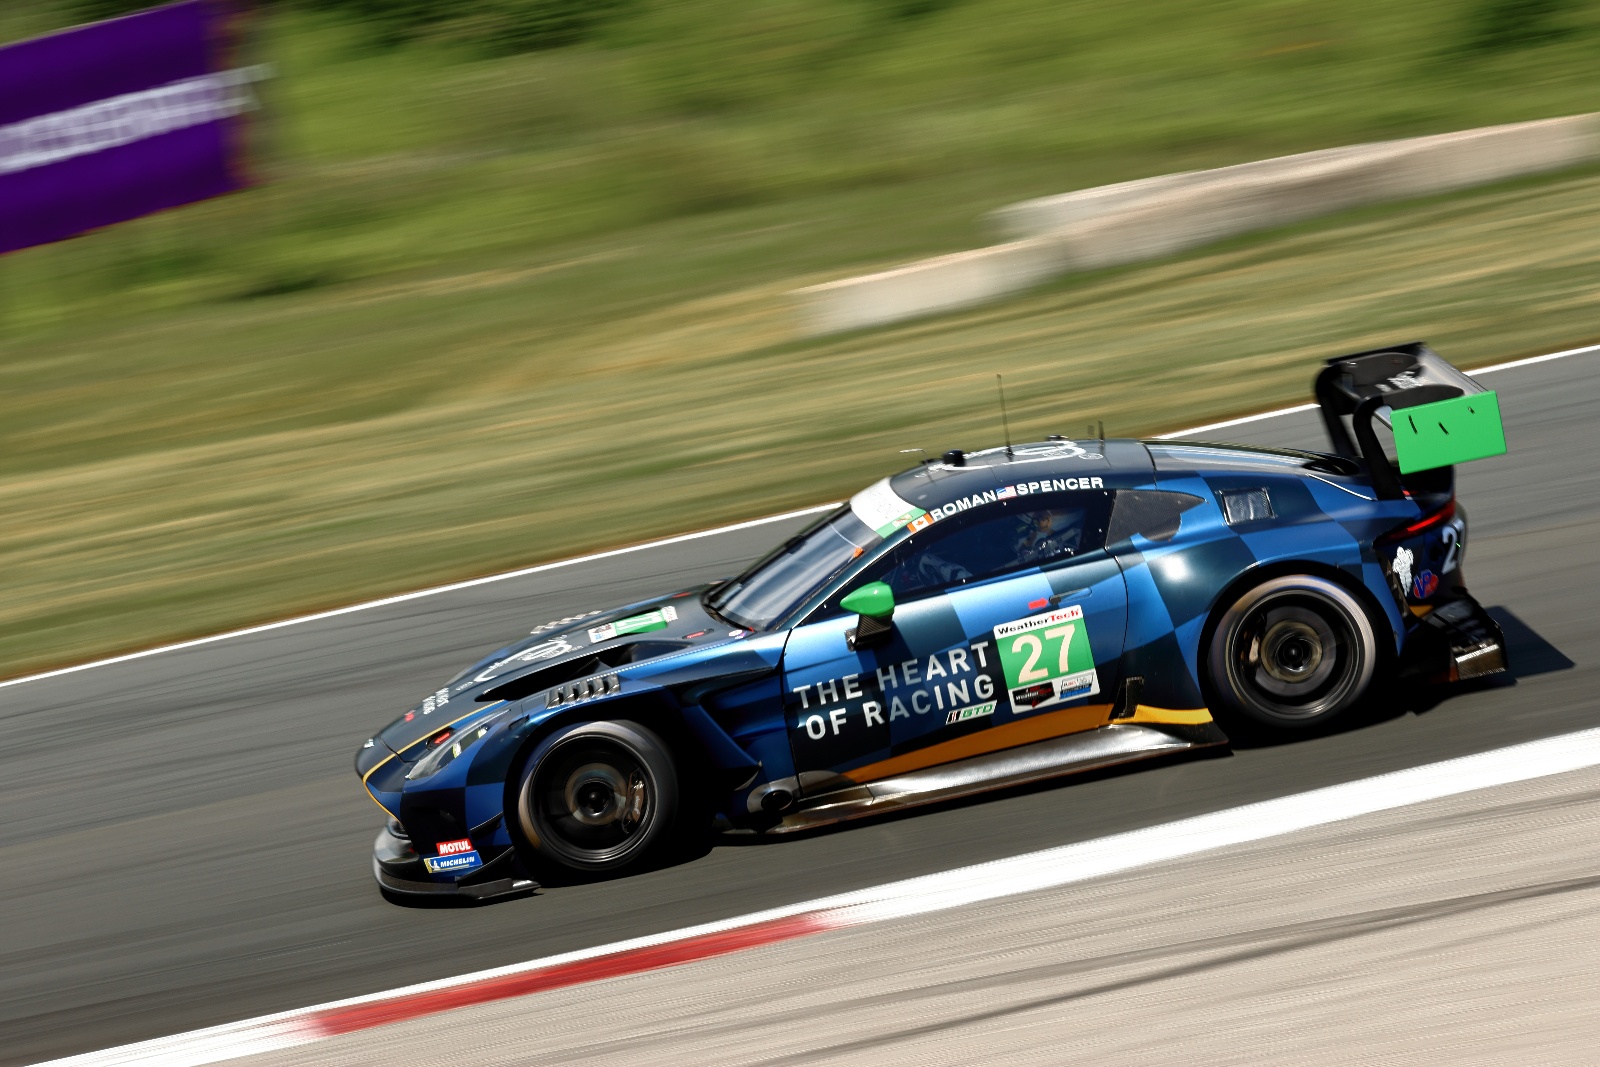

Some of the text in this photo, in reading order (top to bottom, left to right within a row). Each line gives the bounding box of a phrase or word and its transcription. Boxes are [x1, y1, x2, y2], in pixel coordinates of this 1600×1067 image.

[1016, 475, 1104, 496] SPENCER
[930, 489, 998, 521] ROMAN
[997, 608, 1079, 635] WeatherTech
[1011, 623, 1076, 685] 27
[793, 640, 991, 709] THE HEART
[805, 673, 995, 741] OF RACING
[961, 702, 995, 719] GTD
[439, 840, 471, 854] MOTUL
[440, 856, 475, 868] MICHELIN
